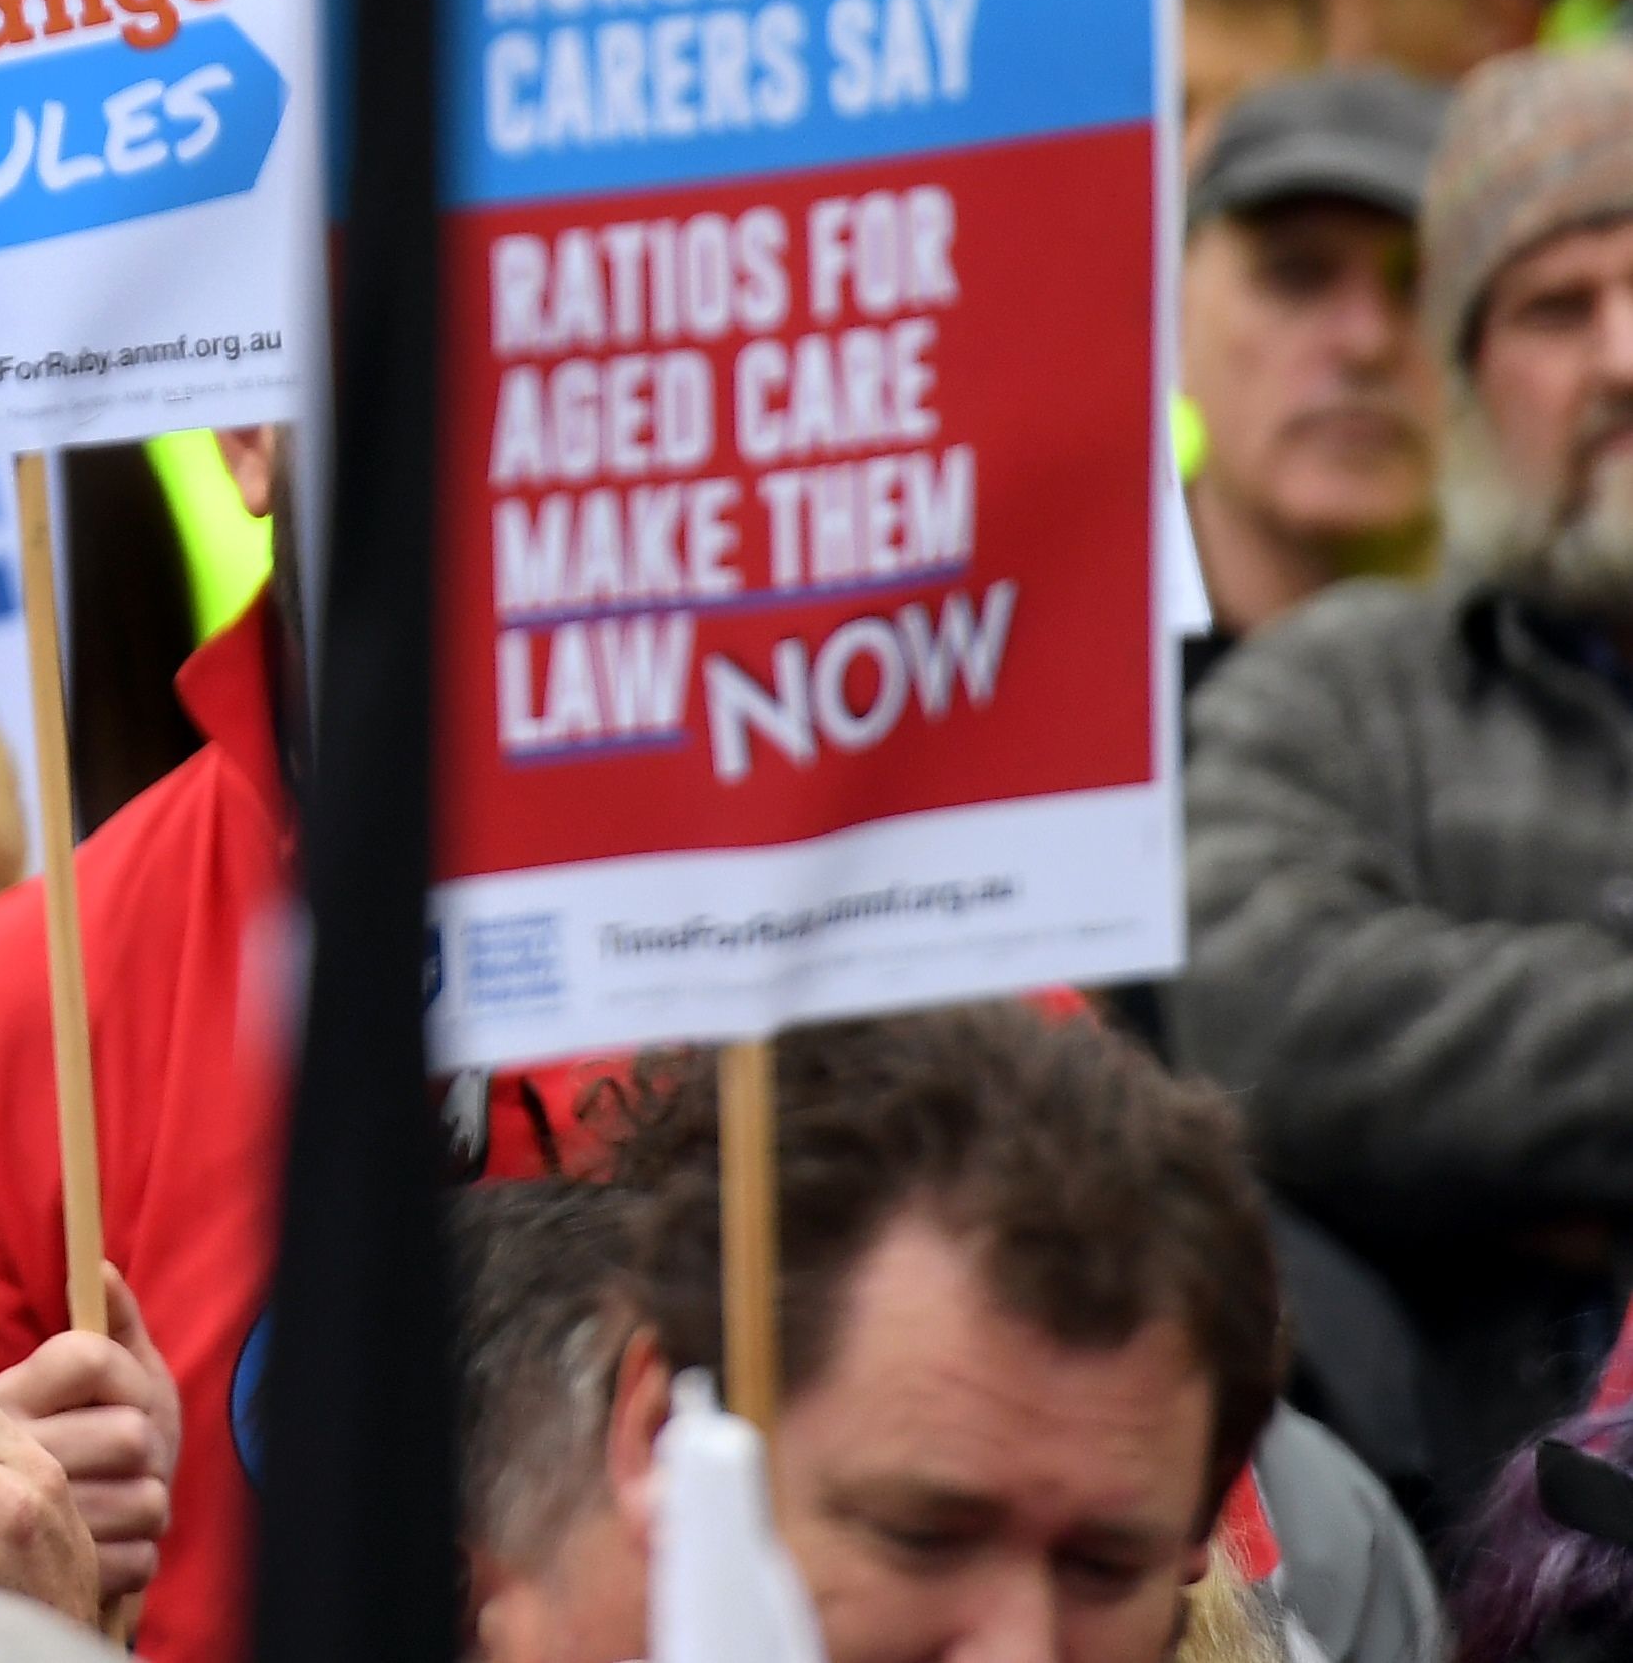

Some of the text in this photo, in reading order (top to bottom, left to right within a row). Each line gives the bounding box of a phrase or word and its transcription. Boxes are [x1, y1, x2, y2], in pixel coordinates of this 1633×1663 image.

[484, 0, 810, 157] CARERS
[489, 185, 958, 361] RATIOS FOR
[487, 317, 940, 487] AGED CARE
[493, 443, 977, 616] MAKE THEM
[498, 580, 1020, 784] LAW NOW
